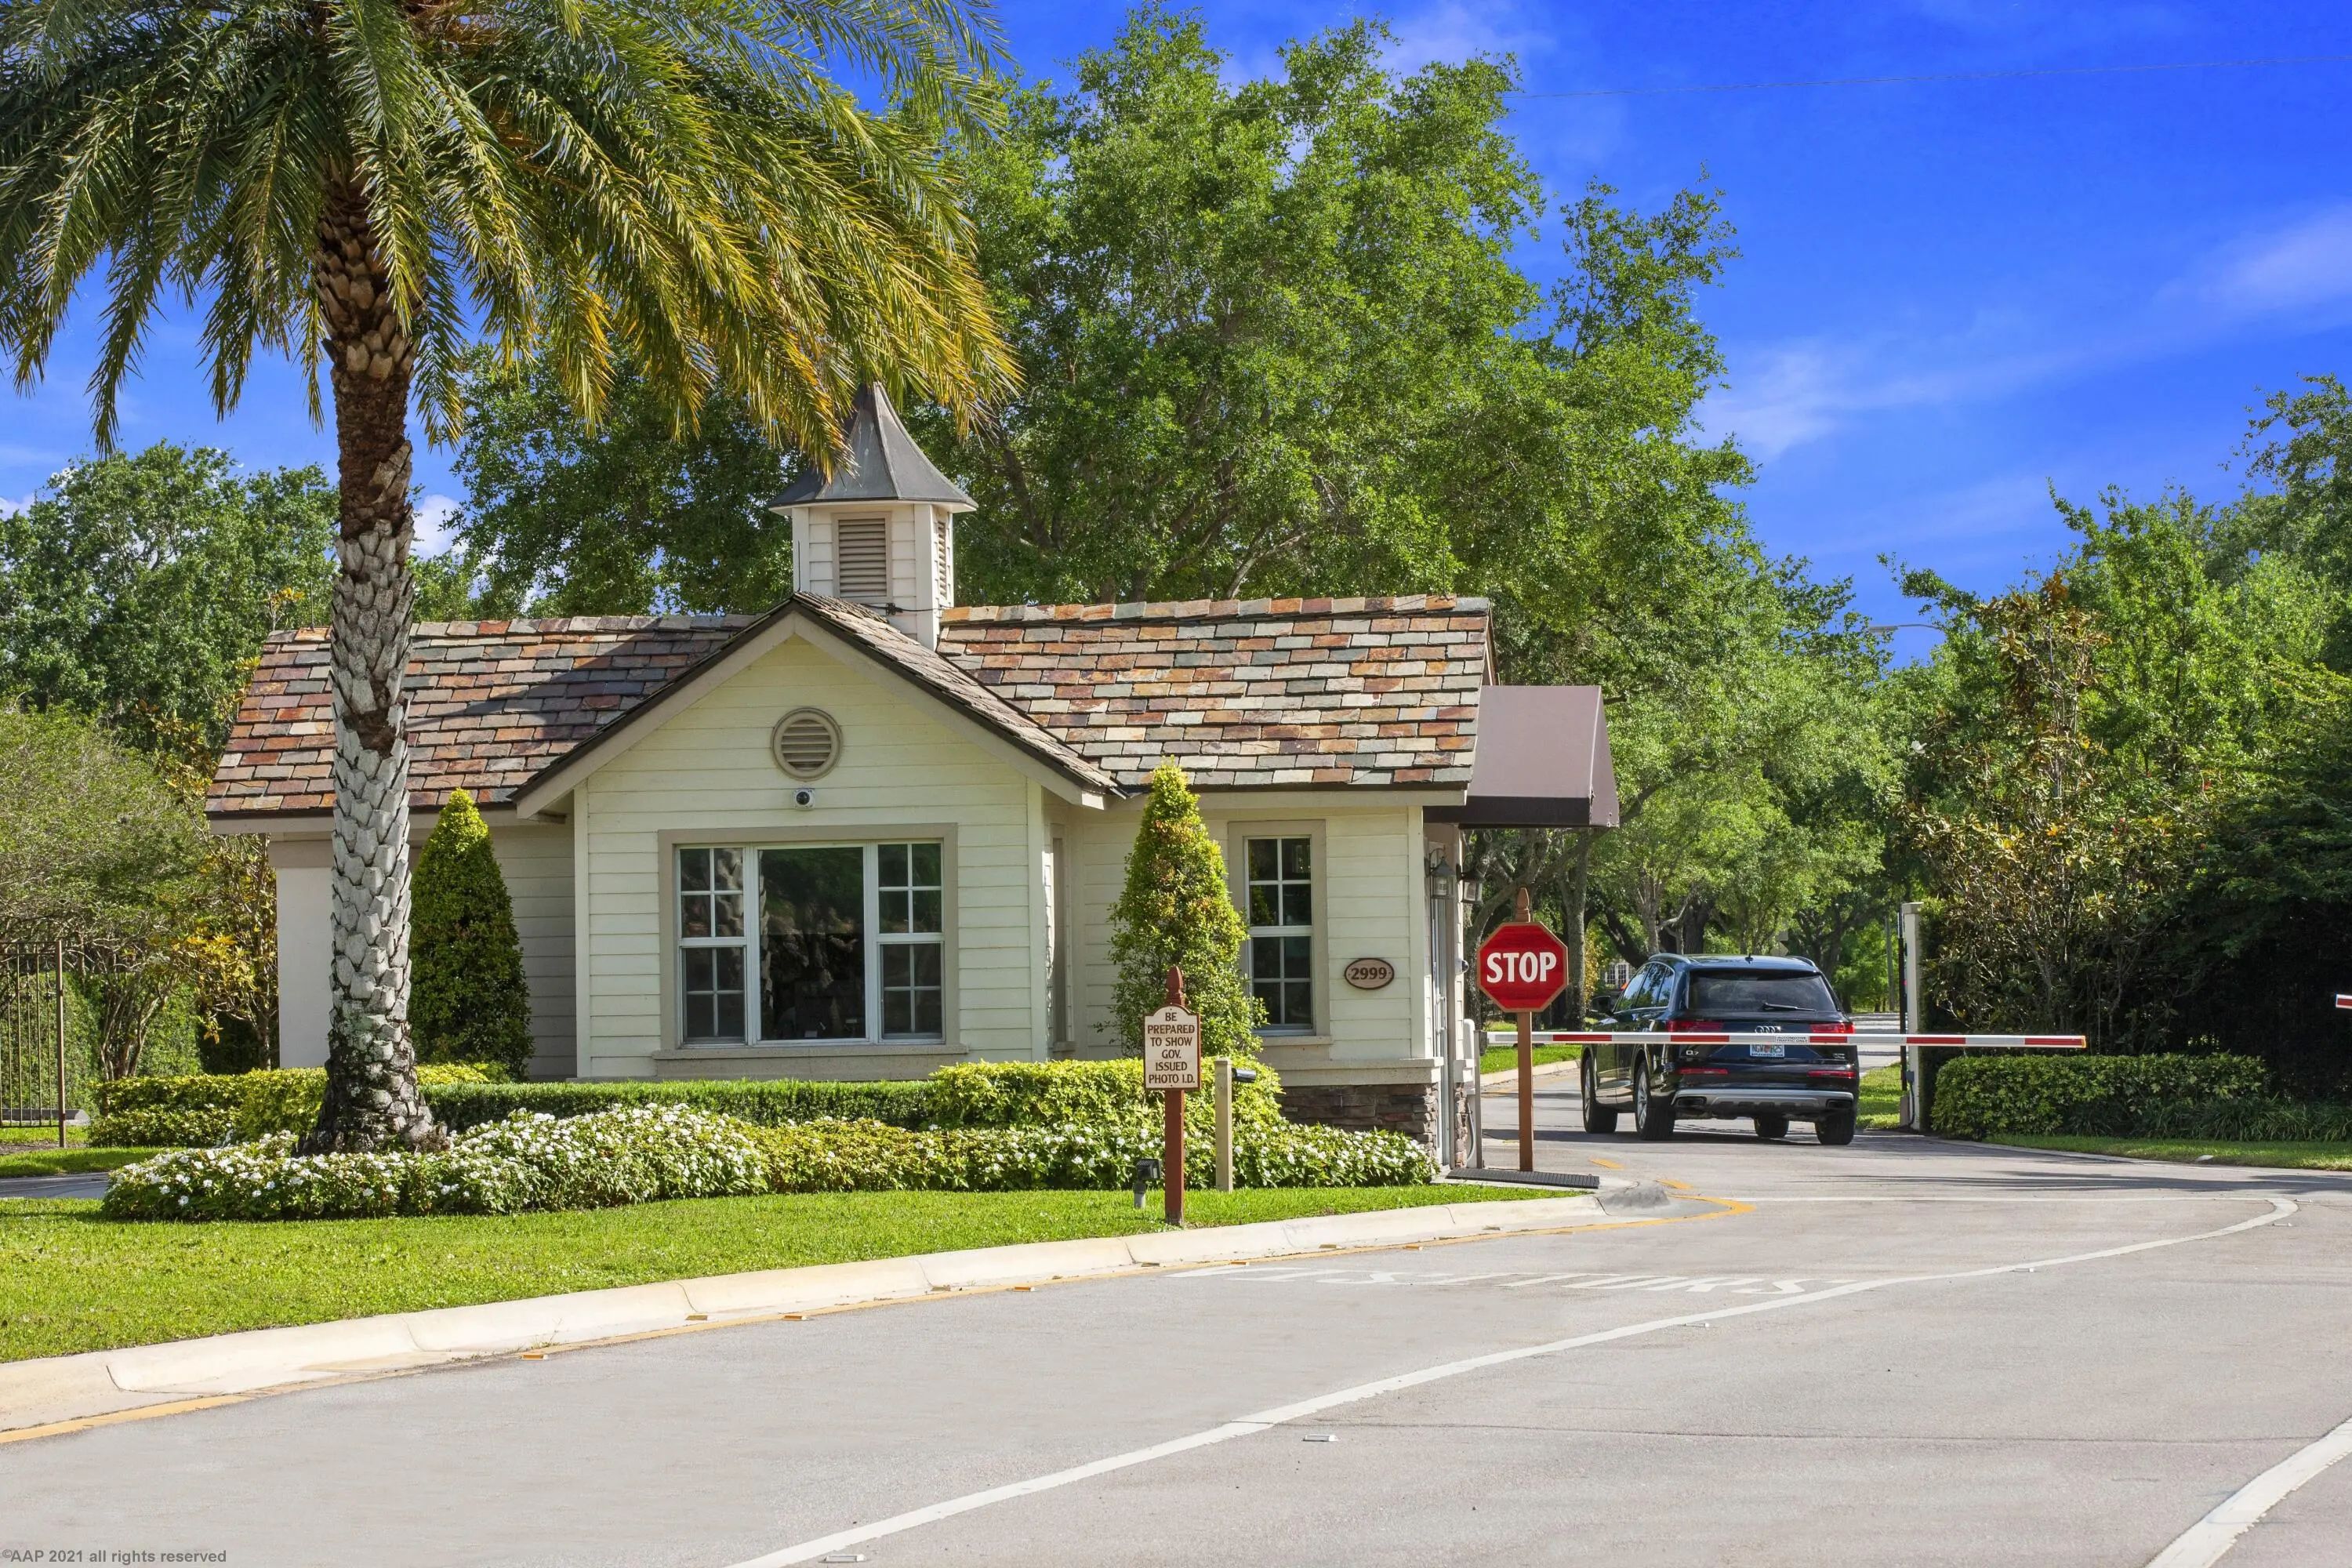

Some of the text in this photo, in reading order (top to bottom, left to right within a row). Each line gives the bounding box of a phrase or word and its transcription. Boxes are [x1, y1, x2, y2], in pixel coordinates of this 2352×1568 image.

[1486, 951, 1557, 983] STOP
[1350, 967, 1388, 980] 2999
[1165, 1012, 1178, 1022] BE
[1147, 1025, 1196, 1034] PREPARED
[1150, 1037, 1192, 1047] TO SHOW
[1162, 1049, 1181, 1058] GOV.
[1156, 1062, 1187, 1071] ISSUED
[1149, 1074, 1195, 1083] PHOTO I.D.
[1163, 1265, 1849, 1294] VISITORS
